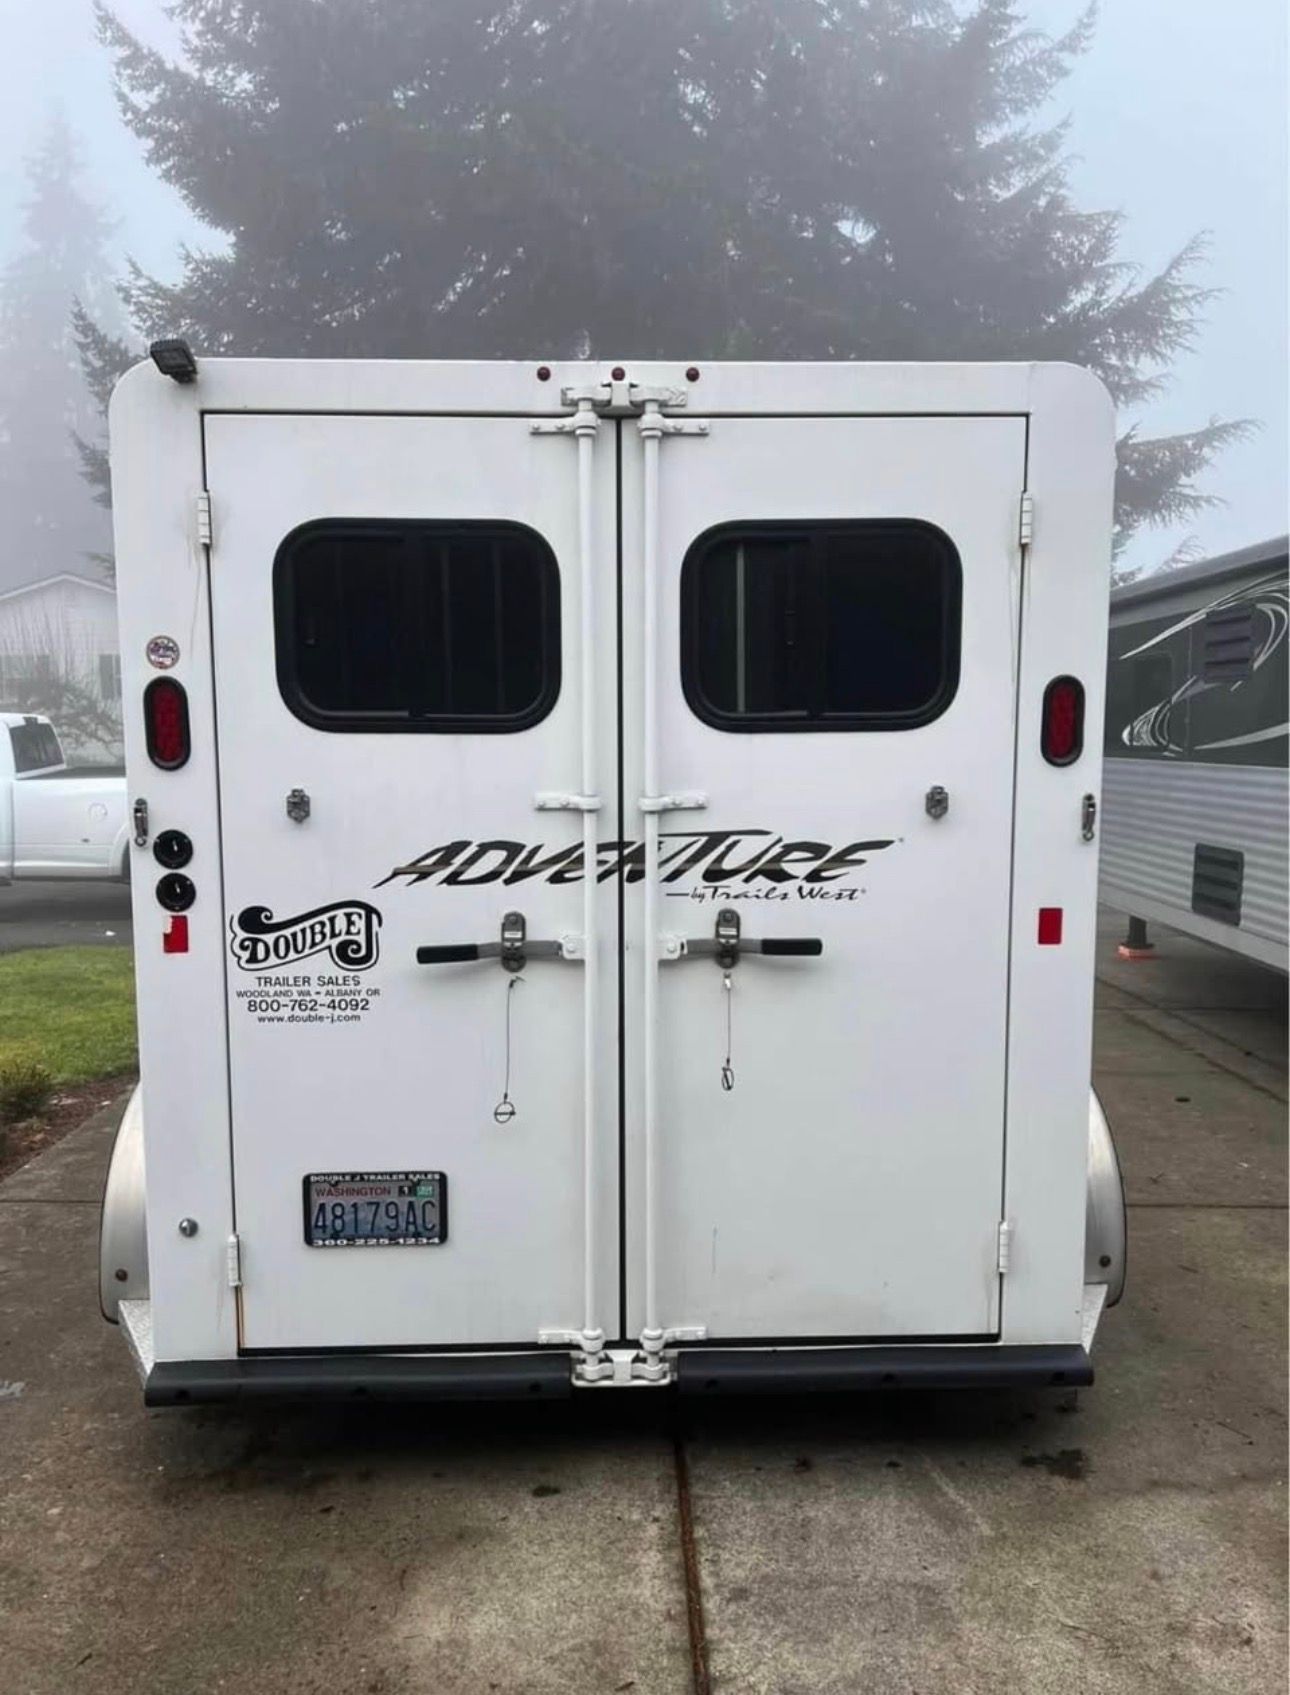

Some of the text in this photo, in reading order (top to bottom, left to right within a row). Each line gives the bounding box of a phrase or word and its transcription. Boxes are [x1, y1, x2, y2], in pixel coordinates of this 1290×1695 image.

[373, 829, 895, 888] ADVENTURE
[703, 885, 789, 901] Trails
[797, 885, 859, 901] West
[239, 912, 362, 964] DOUBLE
[256, 975, 361, 987] TRAILER SALES
[236, 990, 293, 998] WOODLAND
[296, 989, 312, 998] WA
[325, 989, 362, 997] ALBANY
[366, 988, 380, 997] OR
[247, 998, 370, 1013] 800-762-4092
[257, 1013, 361, 1024] www.double-j.com
[310, 1174, 351, 1182] DOUBLE
[363, 1173, 406, 1181] TRAILER
[408, 1173, 440, 1181] SALES
[315, 1185, 391, 1197] WASHINGTON
[314, 1200, 436, 1234] 48179AC
[312, 1238, 440, 1246] 360-225-1234
